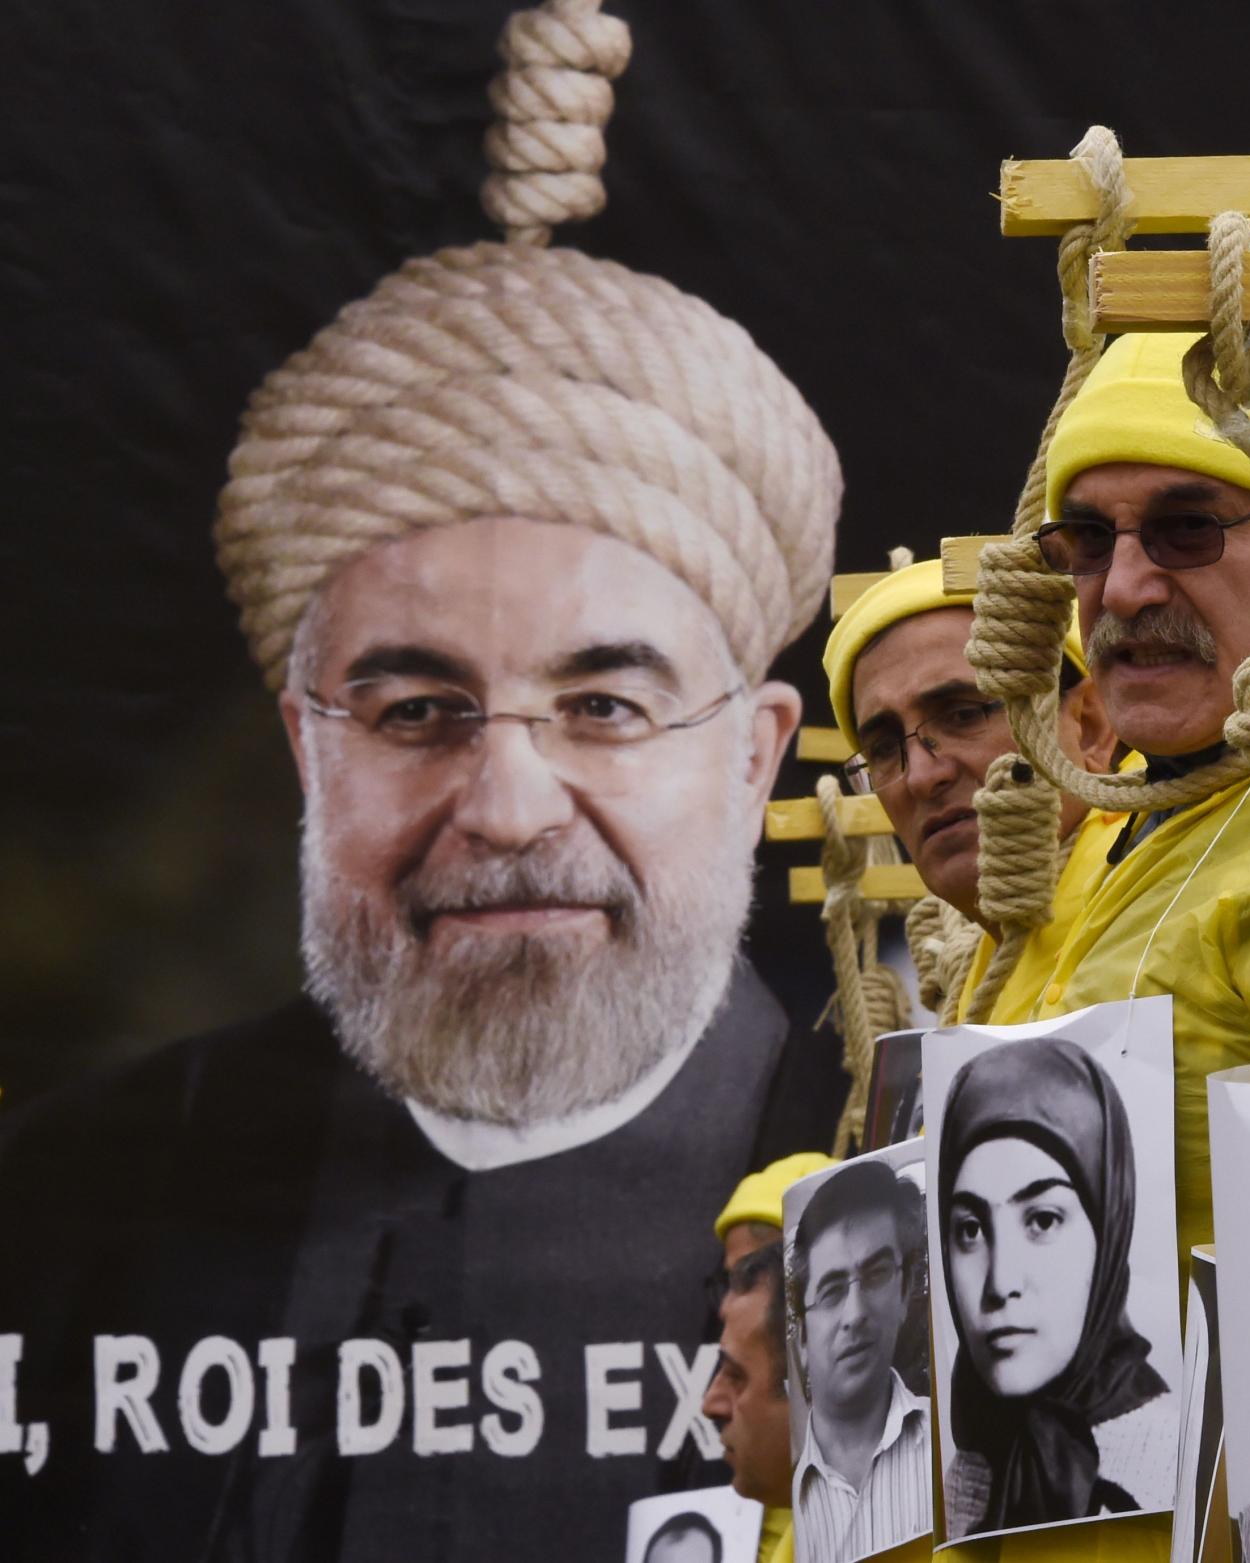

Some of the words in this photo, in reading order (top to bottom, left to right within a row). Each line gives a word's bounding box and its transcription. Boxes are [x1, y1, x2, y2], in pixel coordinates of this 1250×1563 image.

[94, 1335, 297, 1457] ROI
[337, 1338, 545, 1458] DES
[584, 1341, 729, 1461] EX
